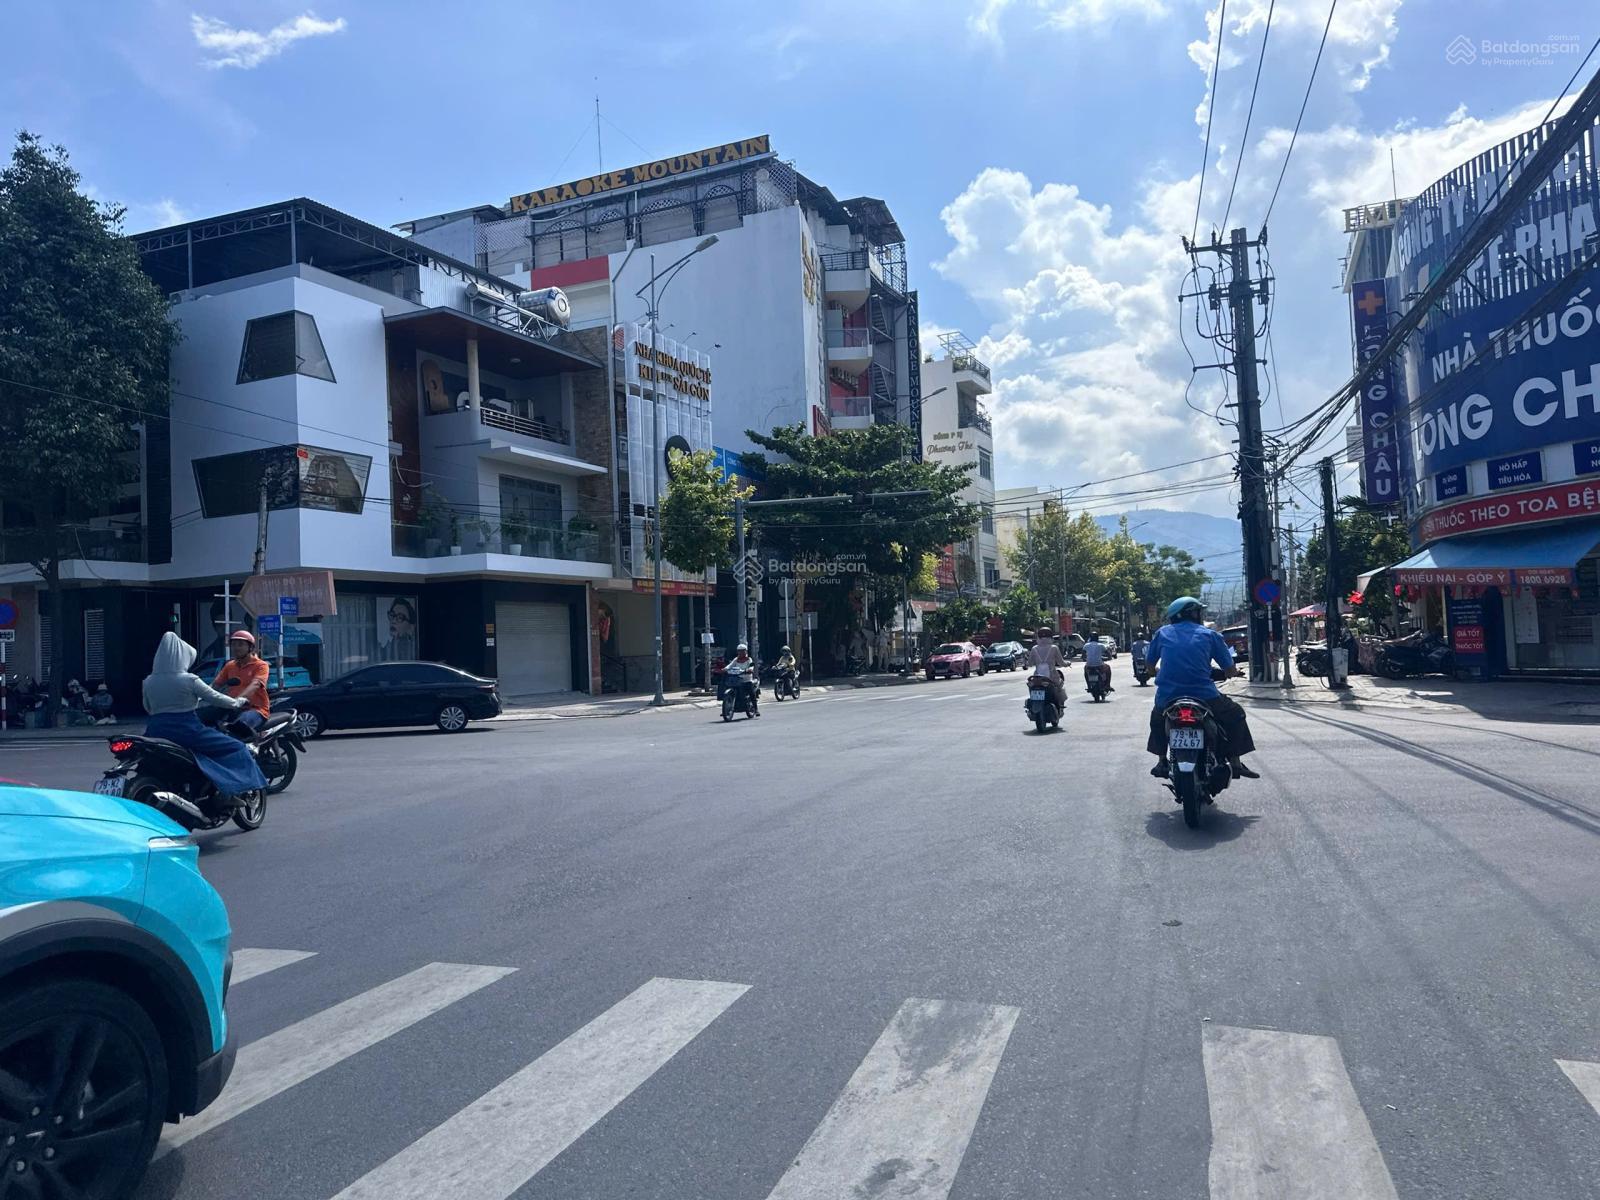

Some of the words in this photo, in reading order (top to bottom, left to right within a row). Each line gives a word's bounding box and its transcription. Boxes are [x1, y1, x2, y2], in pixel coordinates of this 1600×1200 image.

[511, 170, 628, 213] KARAOKE
[632, 136, 768, 184] MOUNTAIN
[1439, 185, 1466, 237] TY
[907, 293, 918, 371] KARAOKE
[1432, 332, 1481, 384] NHÀ
[1488, 287, 1600, 360] THUỐ
[1369, 412, 1392, 496] CHÂU
[1434, 508, 1466, 529] THUỐC
[1470, 504, 1510, 523] THEO
[1517, 496, 1559, 515] TOA
[1567, 487, 1600, 510] BỆ
[1400, 571, 1433, 583] KHIẾU
[1436, 574, 1456, 586] NẠI
[1467, 571, 1493, 584] GÓP
[1497, 570, 1505, 583] Ý
[1520, 575, 1541, 584] 1800
